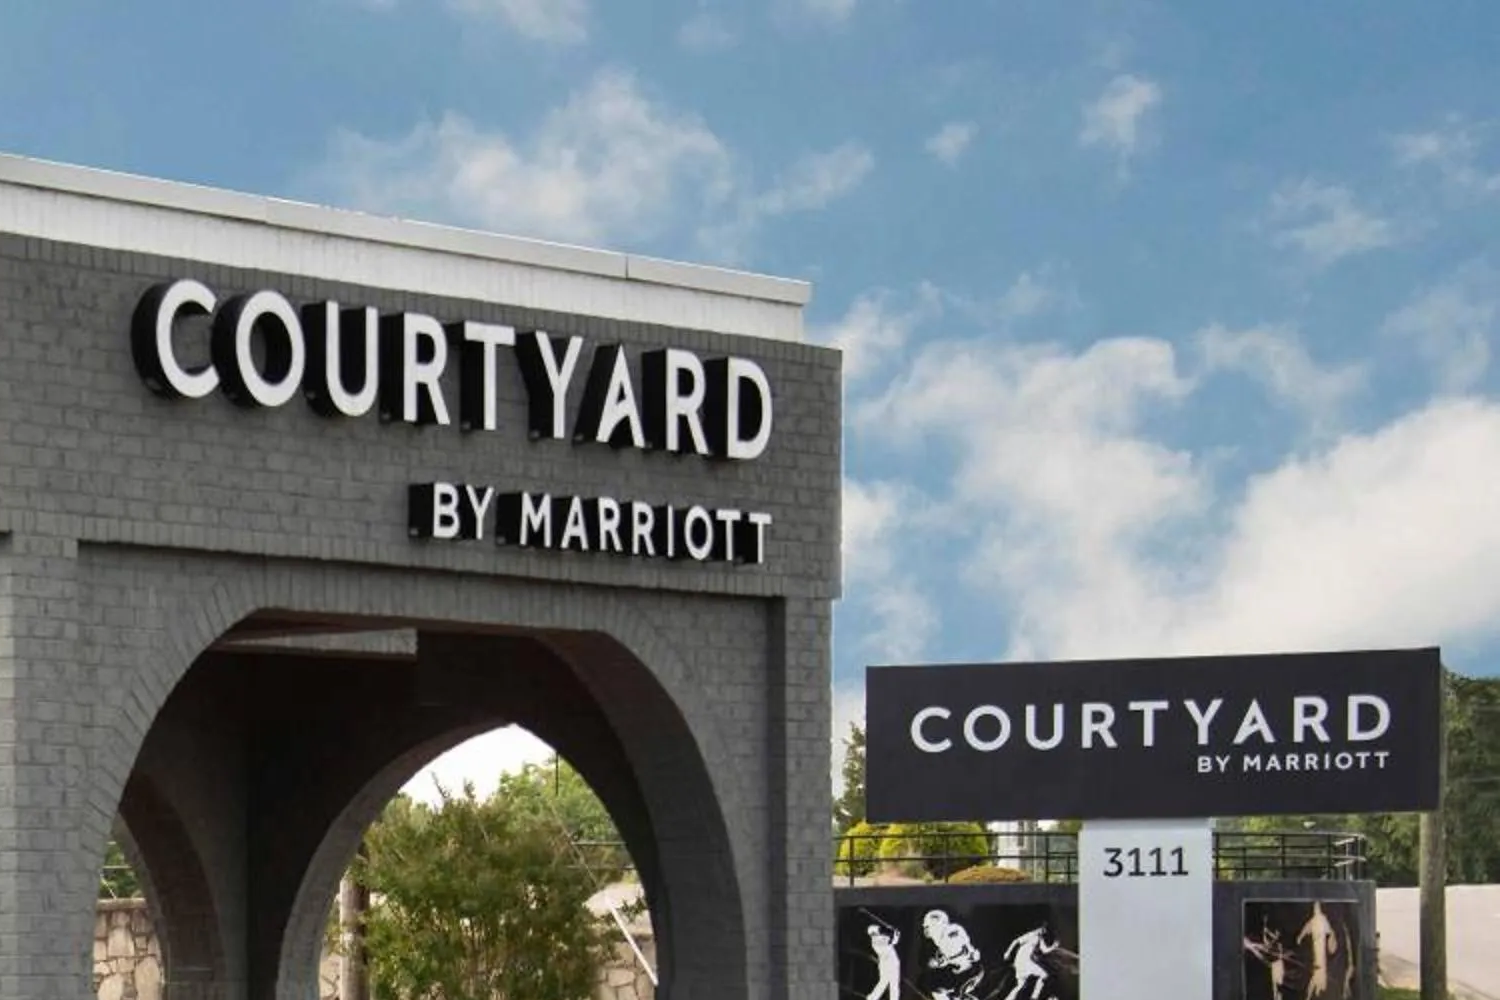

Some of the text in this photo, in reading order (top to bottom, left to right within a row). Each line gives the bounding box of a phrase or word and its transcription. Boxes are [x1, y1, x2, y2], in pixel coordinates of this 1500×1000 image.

[154, 277, 774, 461] COURTYARD
[430, 481, 774, 566] BY MARRIOTT
[908, 693, 1393, 754] COURTYARD
[1196, 750, 1391, 774] BY MARRIOTT
[1101, 846, 1190, 879] 3111
